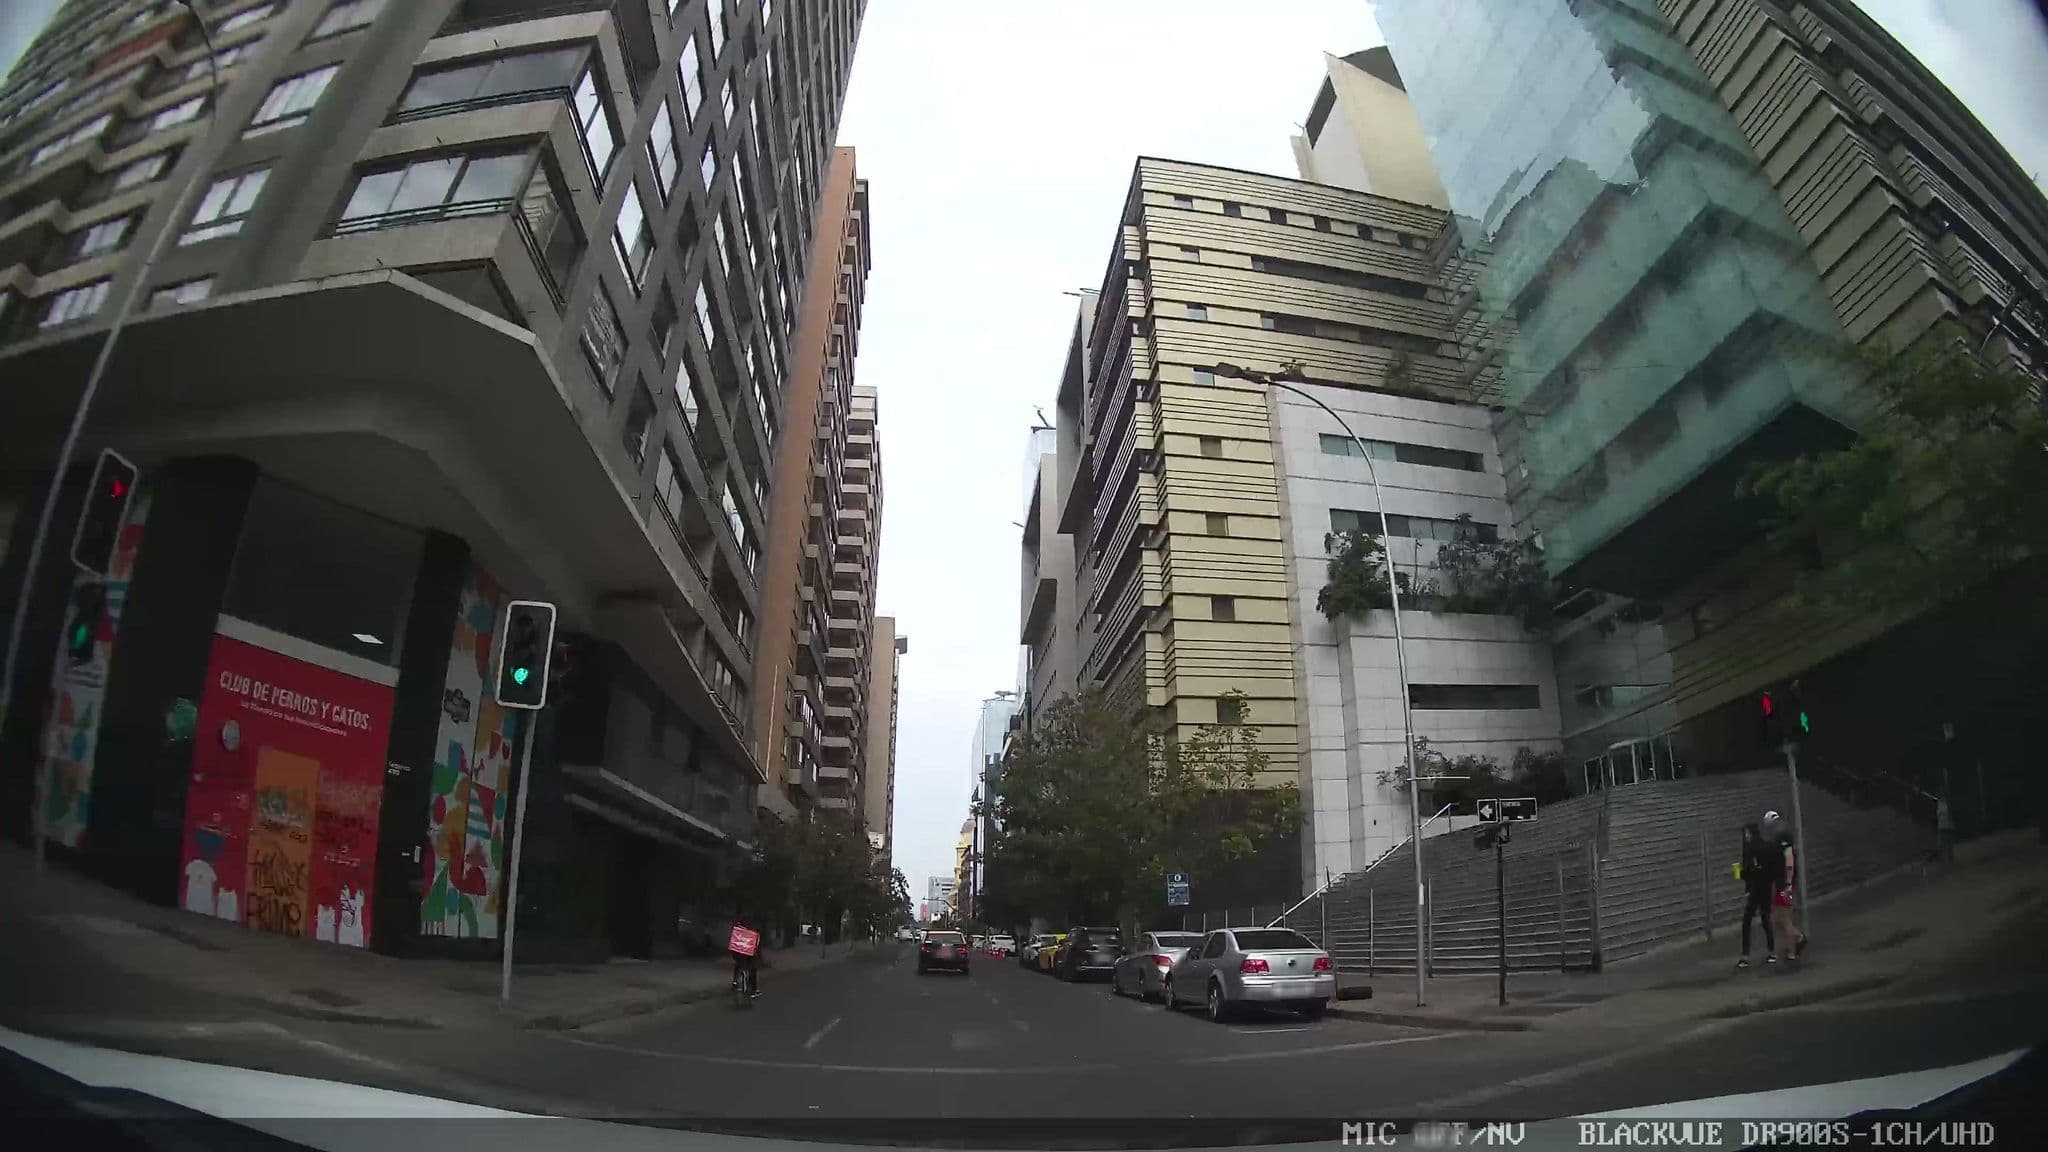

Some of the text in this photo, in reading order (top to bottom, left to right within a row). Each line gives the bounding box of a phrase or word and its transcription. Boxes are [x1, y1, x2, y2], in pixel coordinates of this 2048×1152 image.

[220, 670, 250, 695] CLUB
[253, 681, 270, 702] DE
[271, 686, 318, 716] PERROS
[321, 703, 332, 719] Y
[332, 706, 370, 730] GATOS
